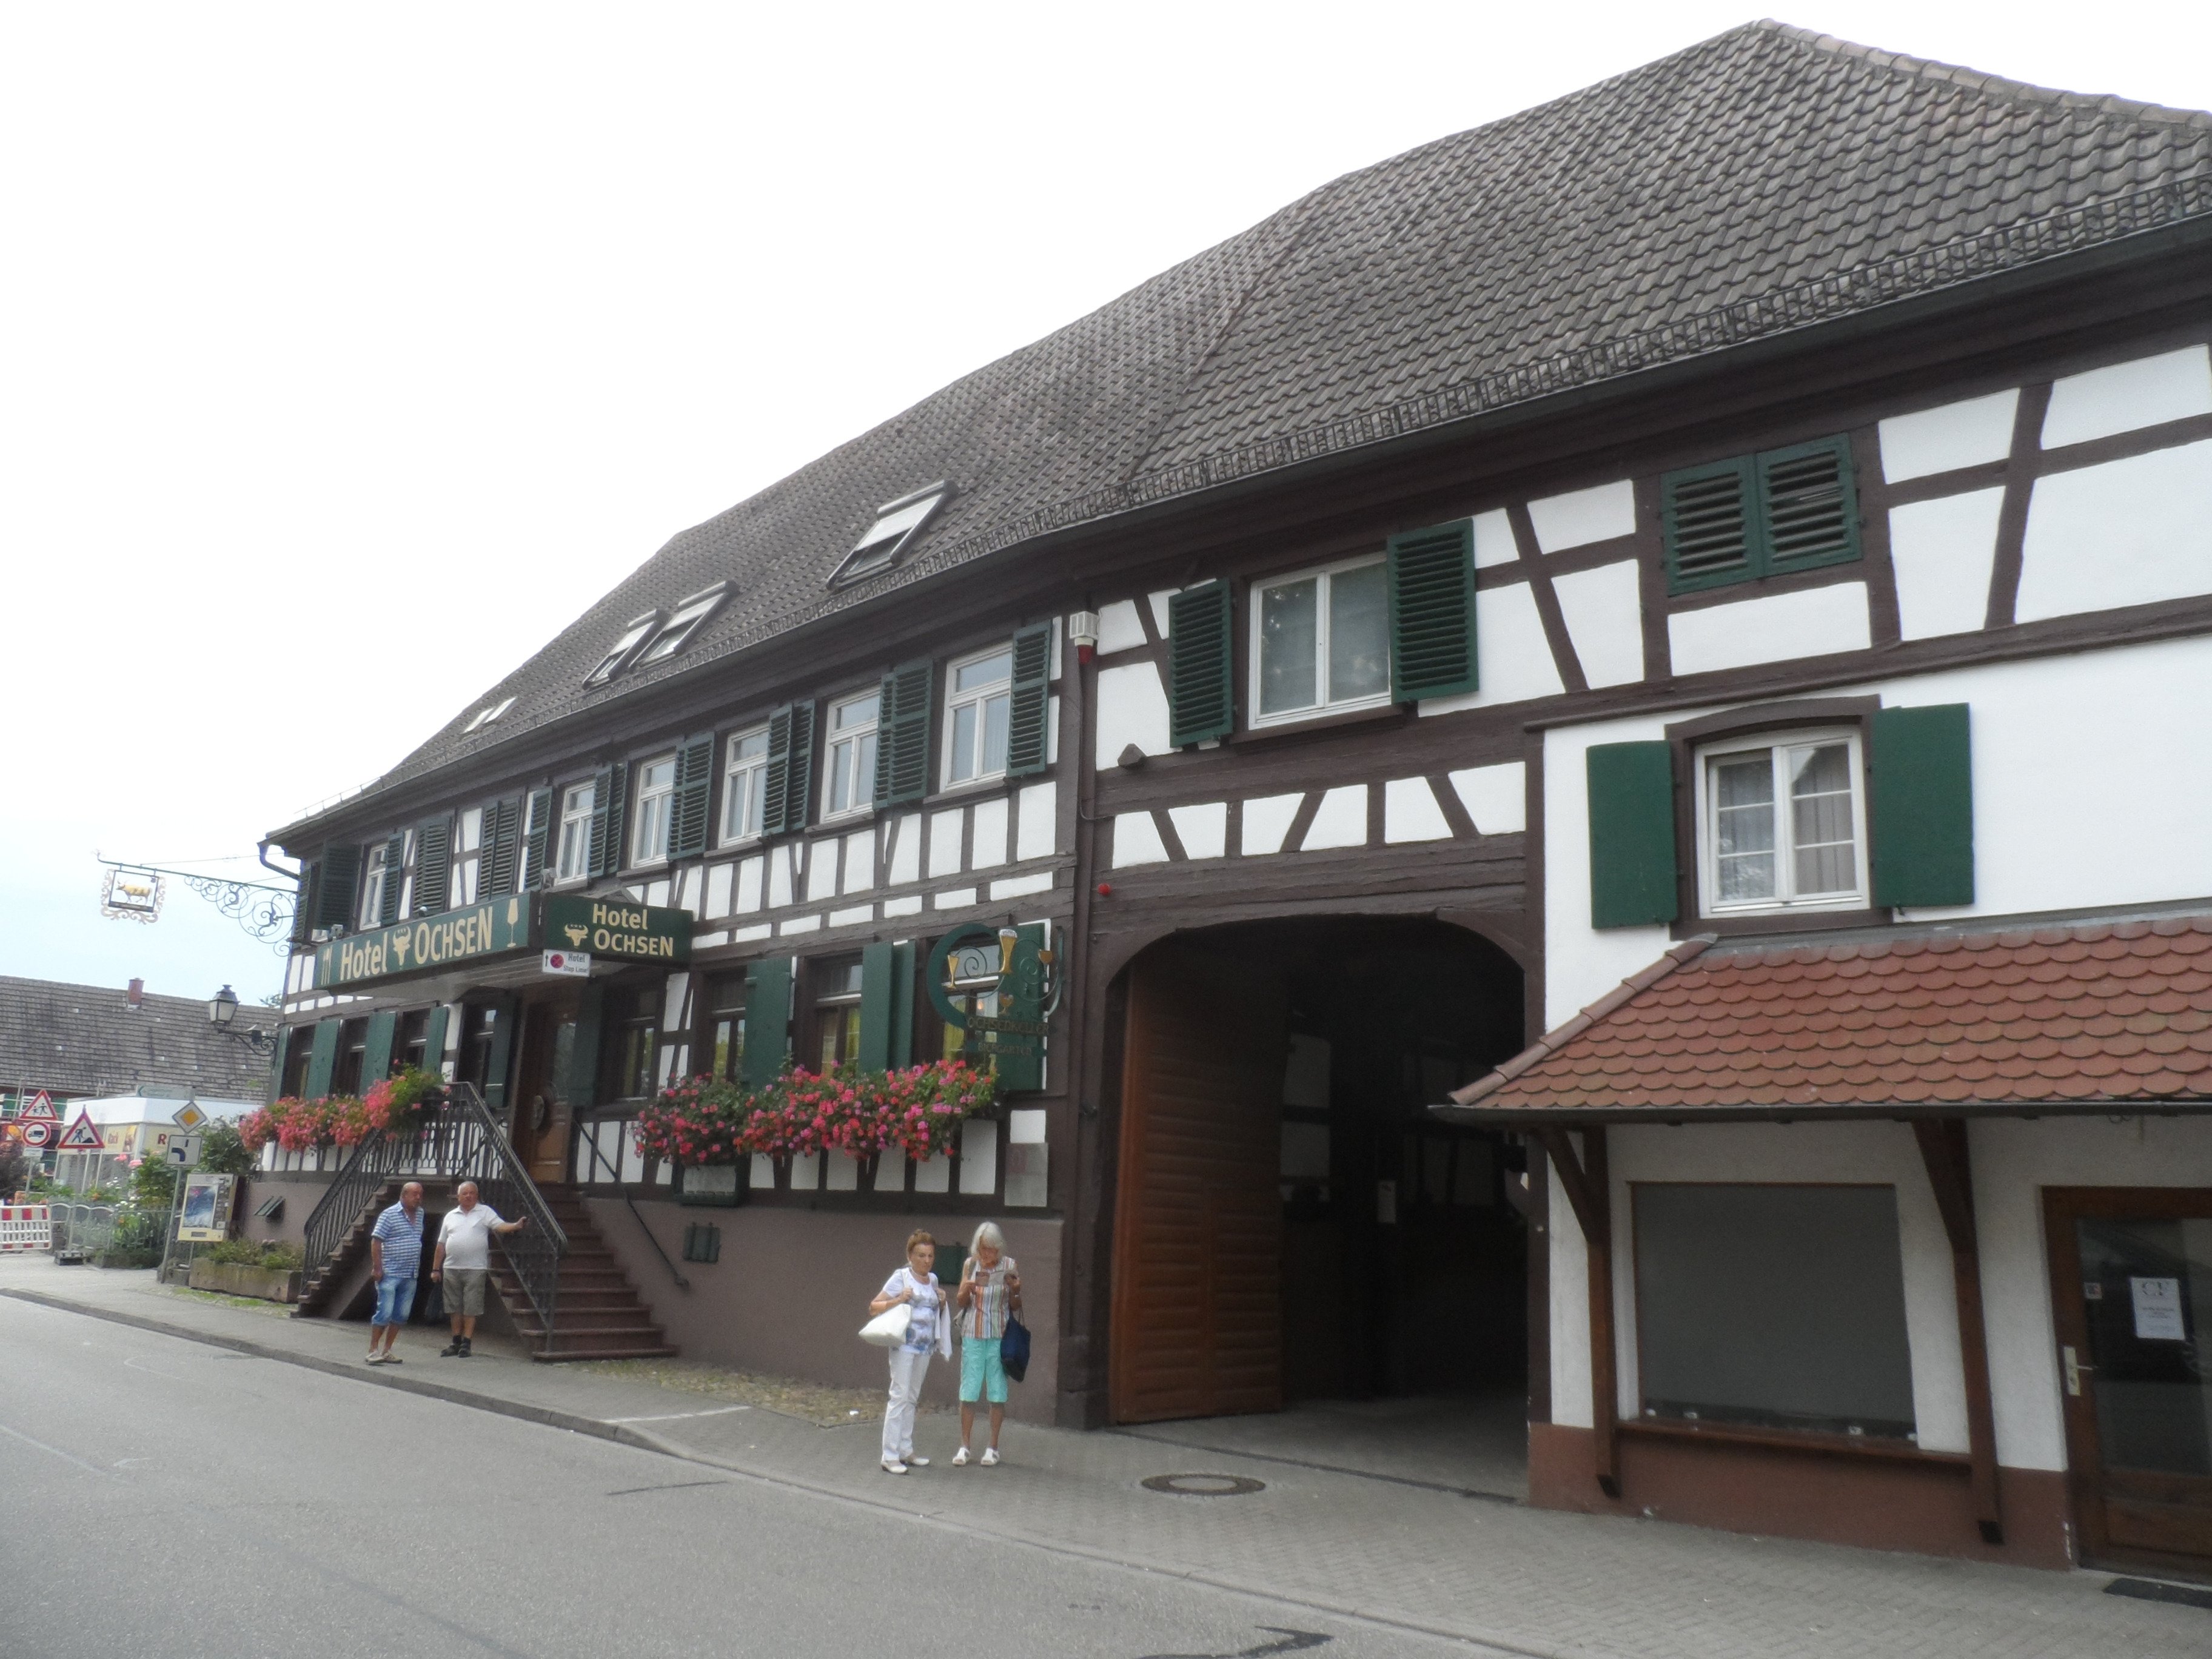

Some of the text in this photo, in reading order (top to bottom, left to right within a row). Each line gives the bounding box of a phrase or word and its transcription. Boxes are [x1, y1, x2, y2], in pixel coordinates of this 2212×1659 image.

[592, 903, 648, 930] Hotel
[340, 906, 493, 981] Hotel OCHSEN
[594, 929, 674, 957] OCHSEN
